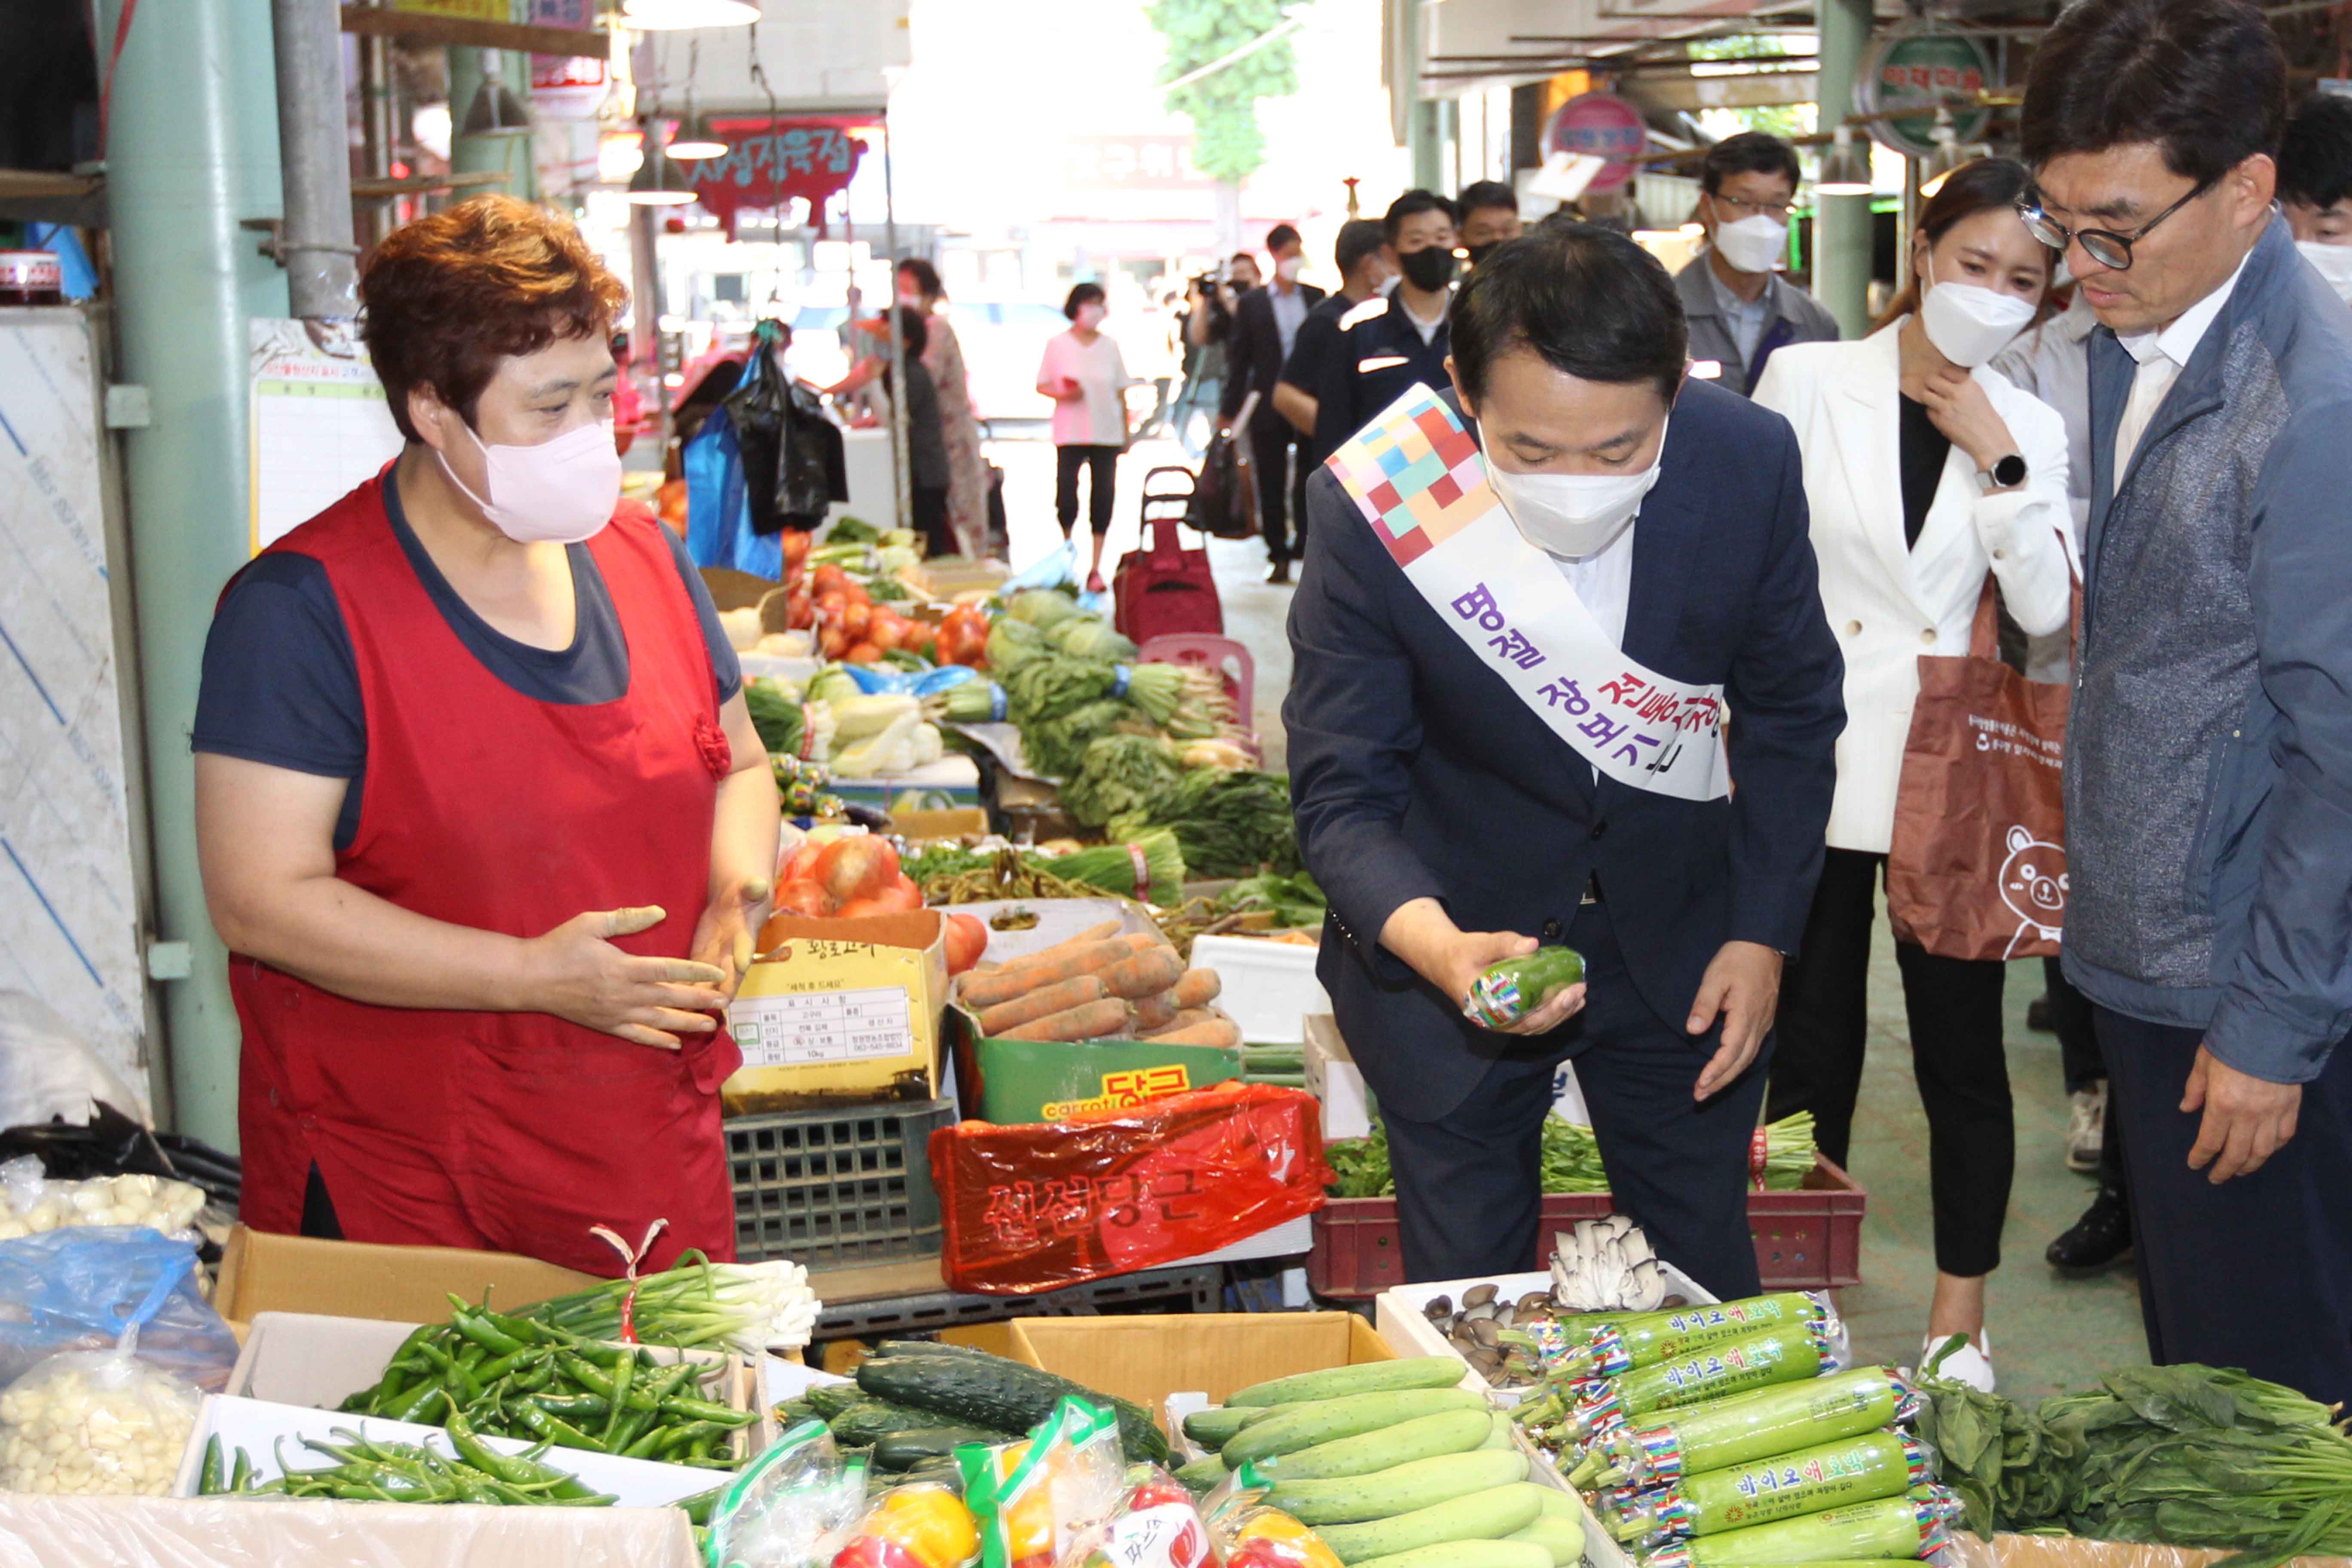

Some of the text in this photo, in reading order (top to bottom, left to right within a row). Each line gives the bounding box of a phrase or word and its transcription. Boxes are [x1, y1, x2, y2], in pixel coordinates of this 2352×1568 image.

[1451, 582, 1547, 670] 명절
[1597, 671, 1720, 738] 전통시장
[807, 1050, 825, 1060] 10kg
[1839, 1480, 1854, 1491] 길다
